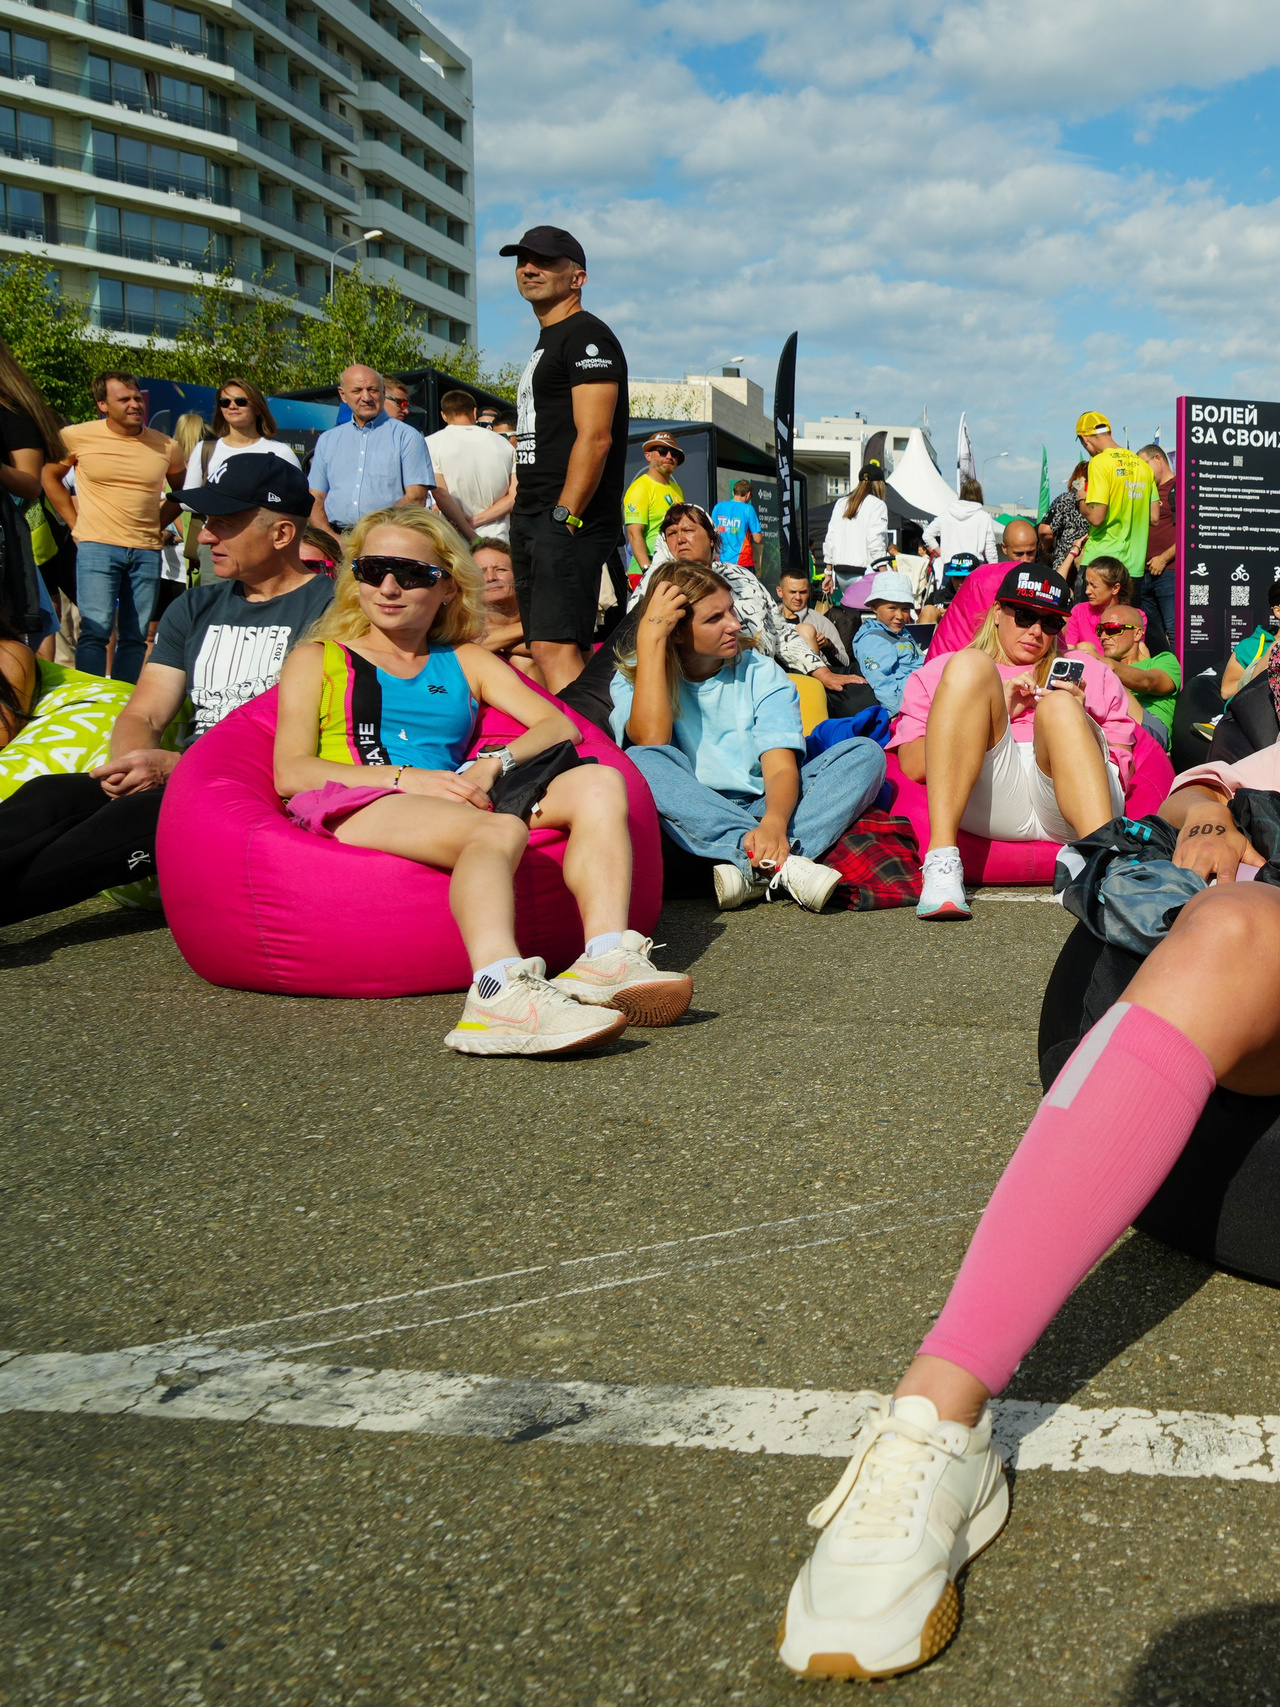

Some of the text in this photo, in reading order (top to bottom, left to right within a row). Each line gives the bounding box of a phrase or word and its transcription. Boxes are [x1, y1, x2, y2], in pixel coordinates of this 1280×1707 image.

[1191, 404, 1258, 425] БОЛЕЙ
[1191, 426, 1218, 445] ЗА
[1016, 588, 1035, 598] 70.3
[1017, 580, 1062, 597] IRONMAN
[273, 642, 284, 661] 2023
[1188, 823, 1226, 838] 809
